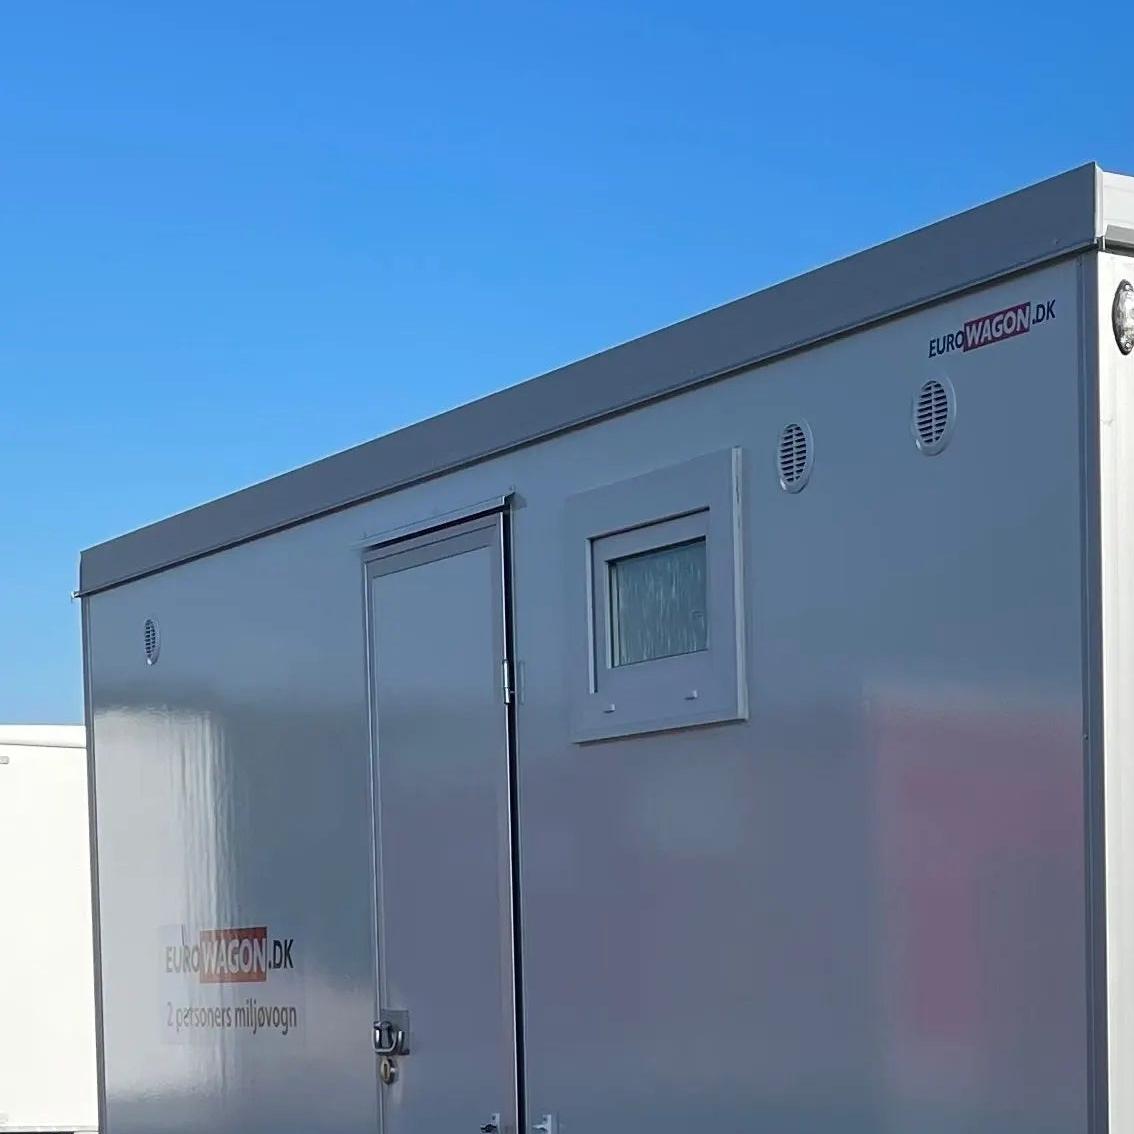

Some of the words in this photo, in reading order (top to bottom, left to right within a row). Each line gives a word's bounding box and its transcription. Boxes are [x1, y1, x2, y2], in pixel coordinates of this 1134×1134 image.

[928, 299, 1056, 358] EUROWAGON.DK
[165, 934, 294, 977] EUROWAGON.DK
[176, 1006, 232, 1033] personers
[235, 998, 297, 1036] miljøvogn
